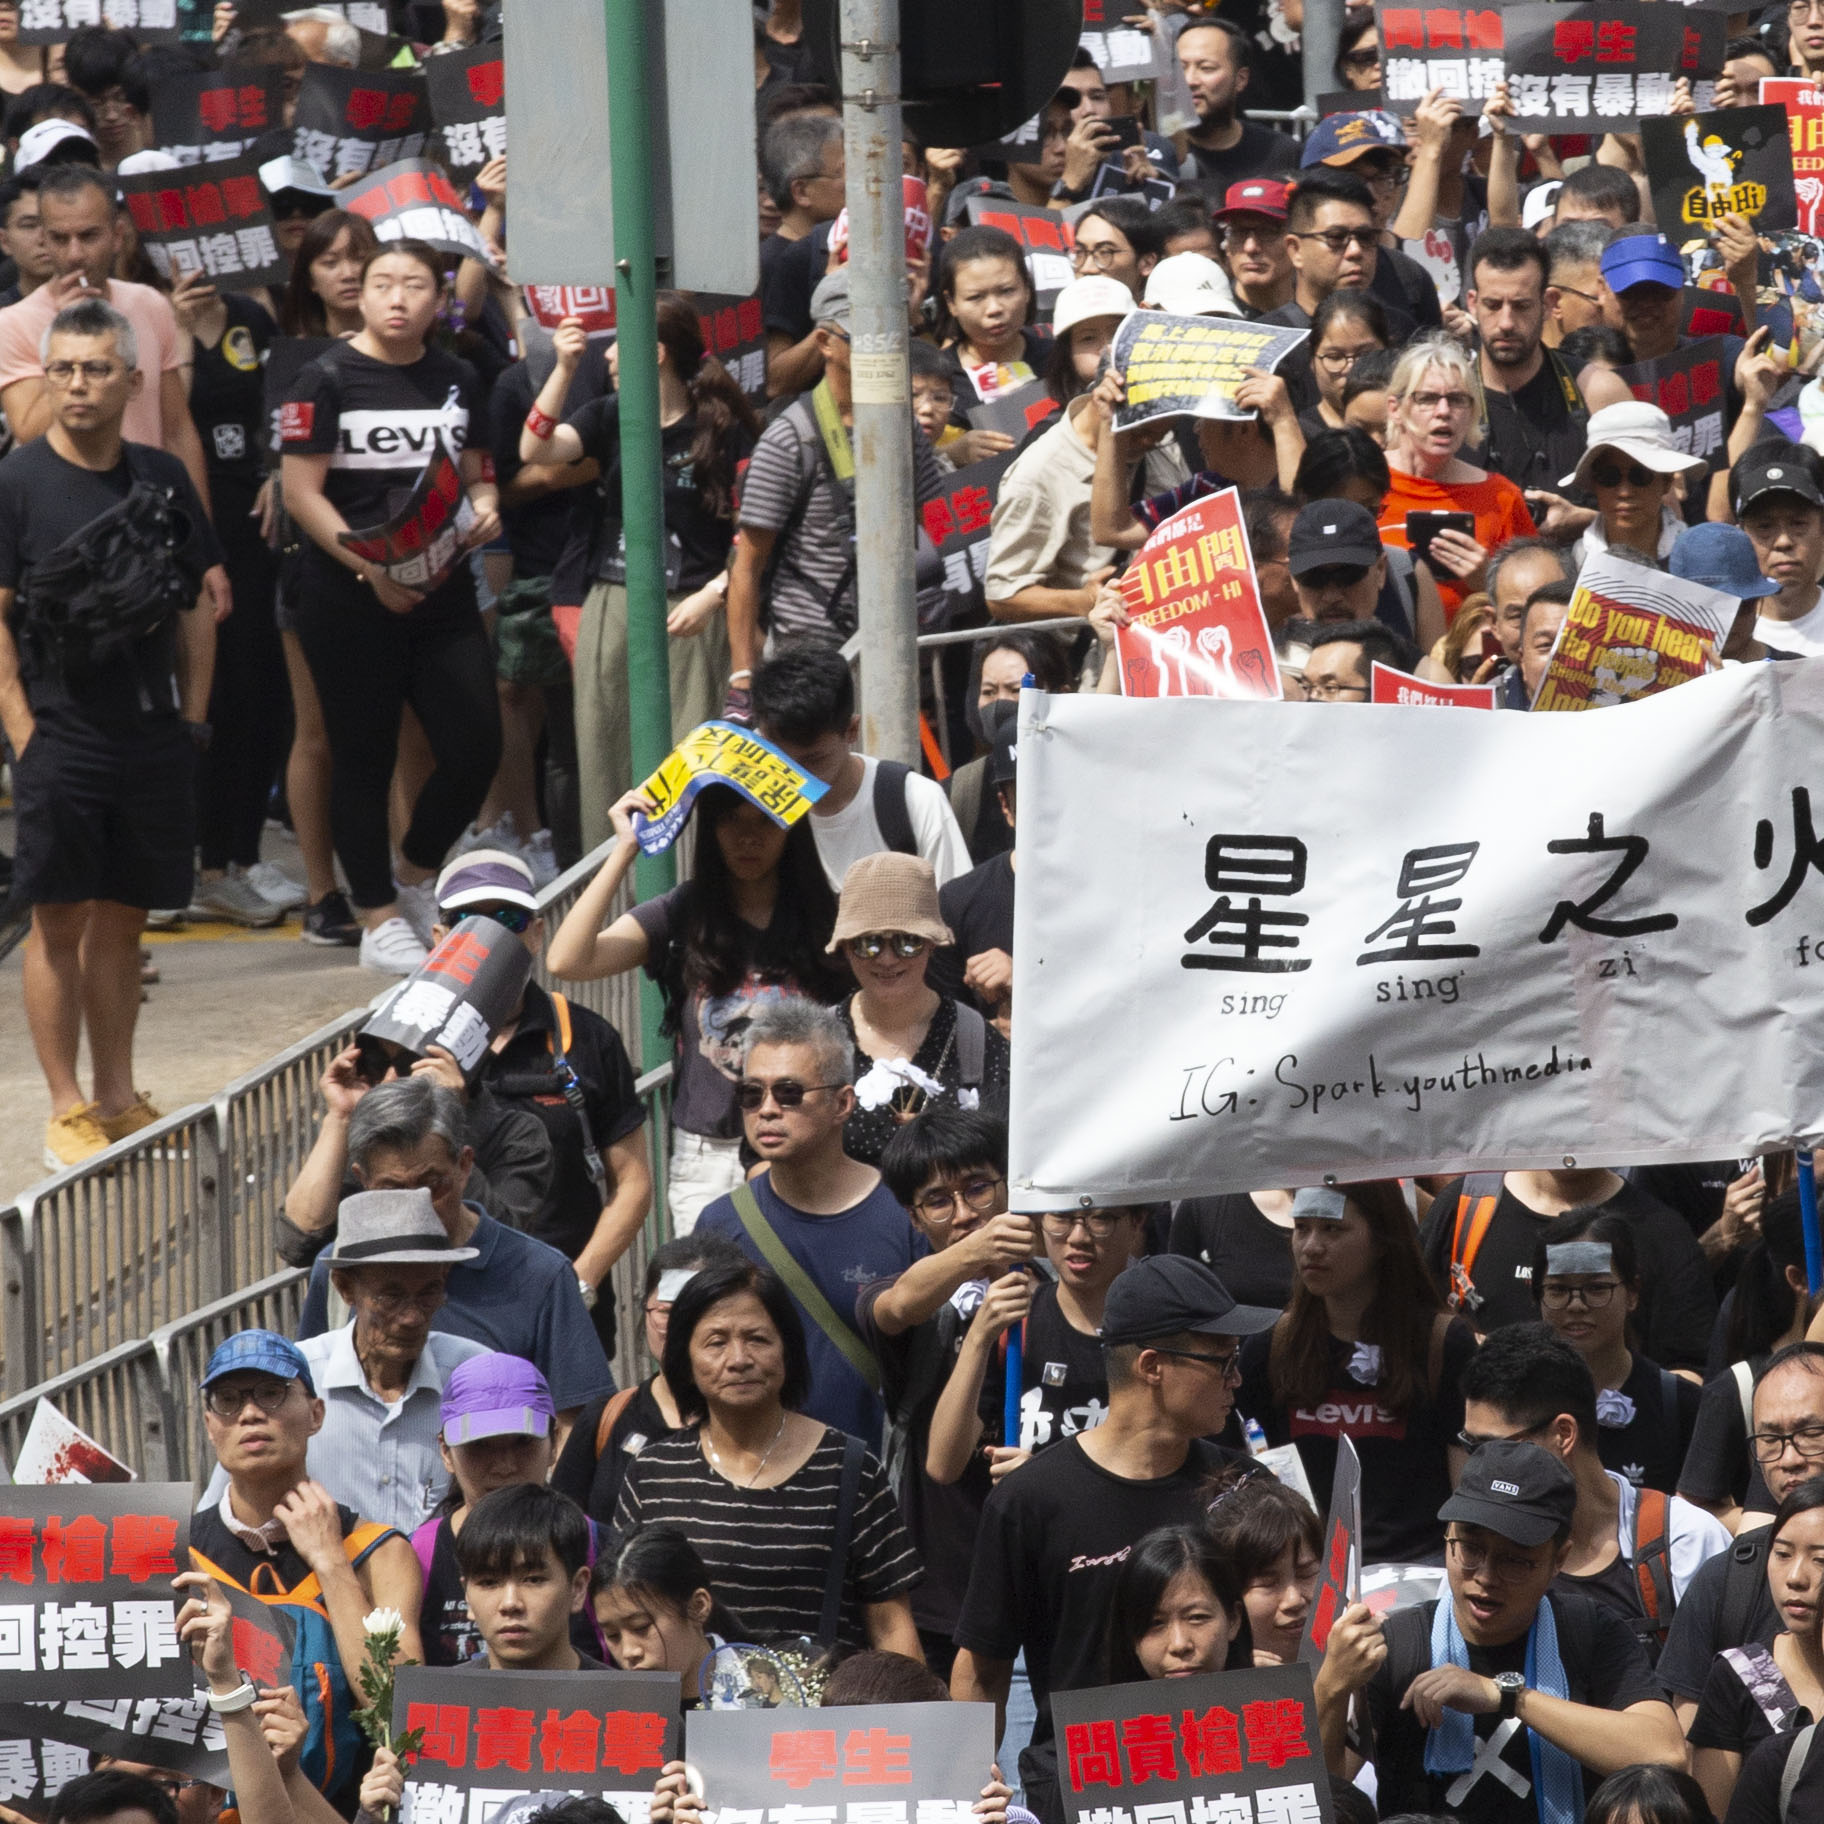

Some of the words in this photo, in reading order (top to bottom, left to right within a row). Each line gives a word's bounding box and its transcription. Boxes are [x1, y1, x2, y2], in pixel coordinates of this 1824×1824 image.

[1384, 10, 1504, 51] 問責槍
[1553, 21, 1639, 65] 學生
[1509, 74, 1680, 118] 沒有暴動
[1222, 579, 1242, 603] HI
[1569, 586, 1599, 627] Do
[1603, 609, 1652, 648] you
[1219, 989, 1288, 1019] sing
[1599, 950, 1637, 978] zi
[1495, 1481, 1518, 1493] VANS
[405, 1703, 669, 1776] 問責槍擊
[770, 1729, 912, 1787] 學生
[1065, 1699, 1313, 1793] 問責槍擊
